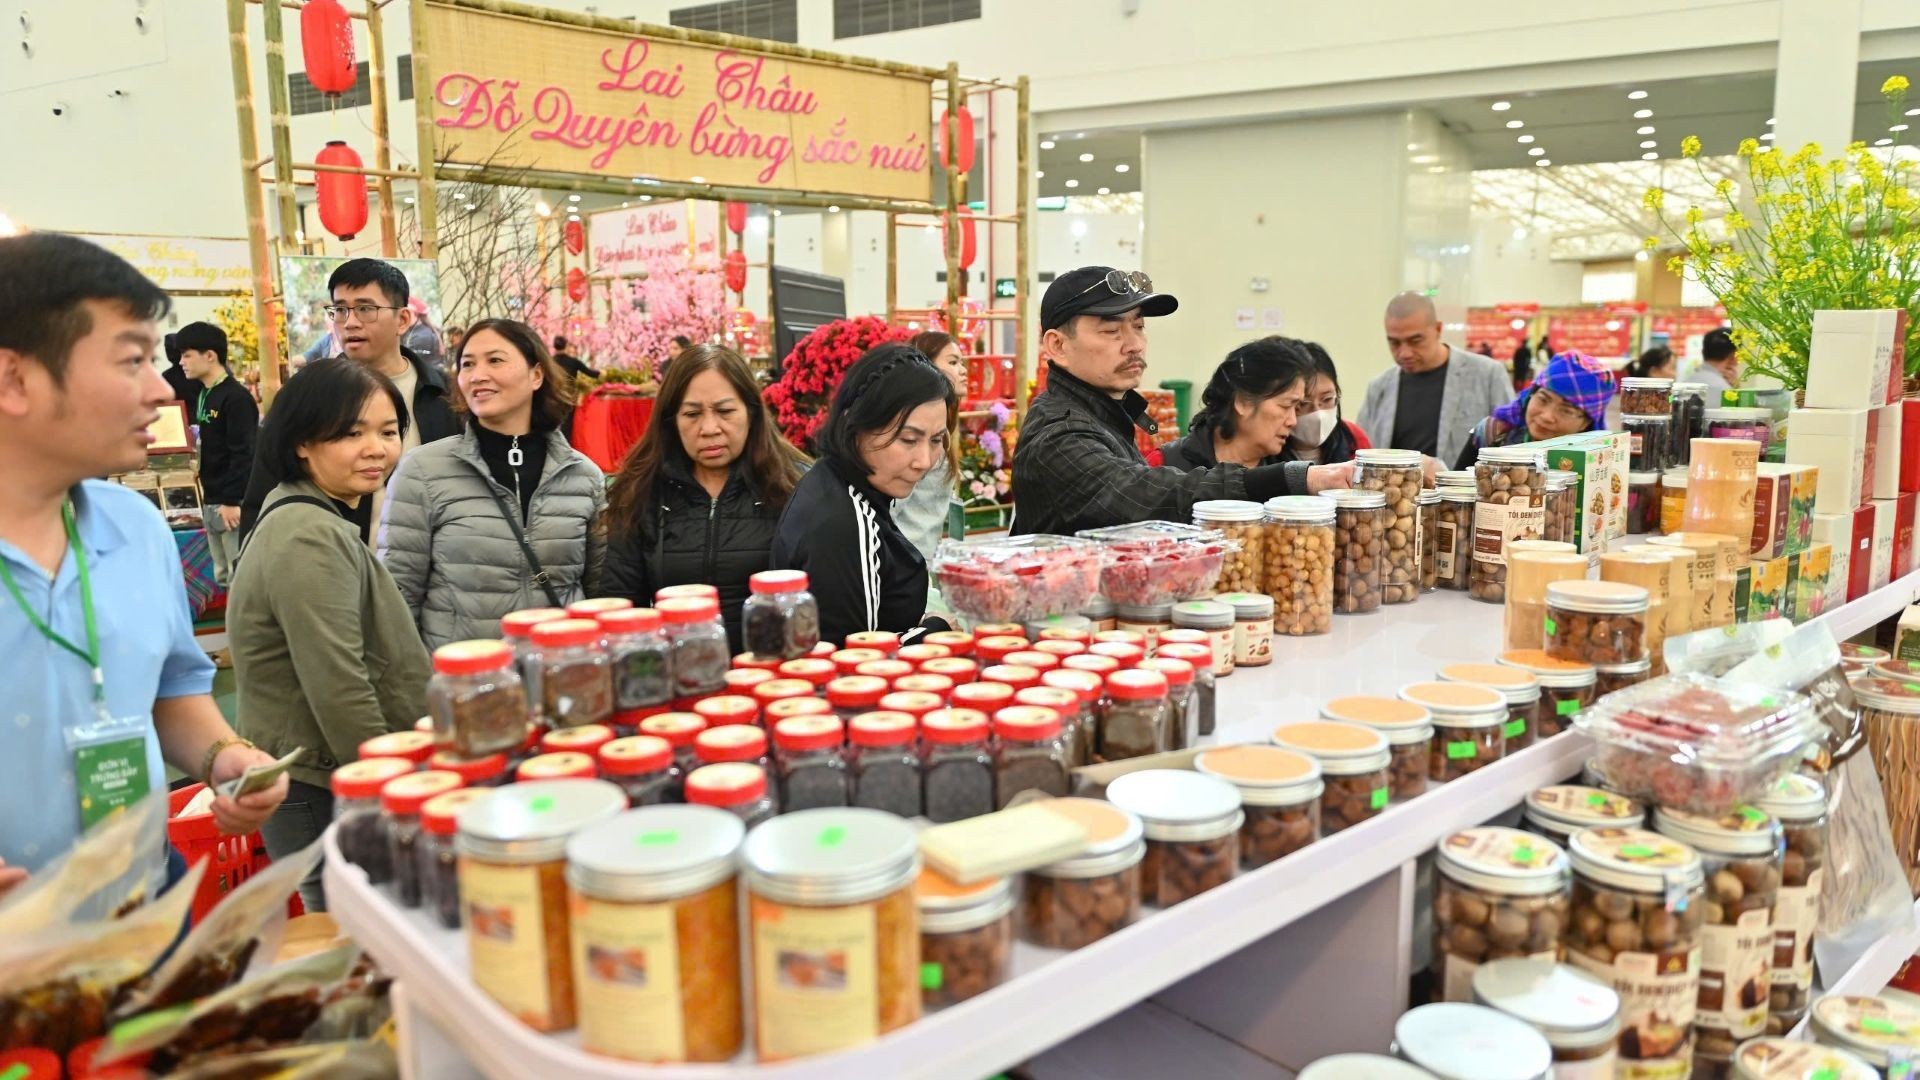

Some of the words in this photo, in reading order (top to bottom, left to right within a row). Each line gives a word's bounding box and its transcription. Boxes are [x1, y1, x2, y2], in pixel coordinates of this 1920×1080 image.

[597, 37, 686, 99] Lai
[715, 49, 818, 116] Châu
[434, 72, 523, 133] Đỗ
[530, 86, 682, 170] Quyên
[689, 101, 795, 184] bừng
[802, 117, 862, 164] sắc
[869, 132, 929, 173] núi
